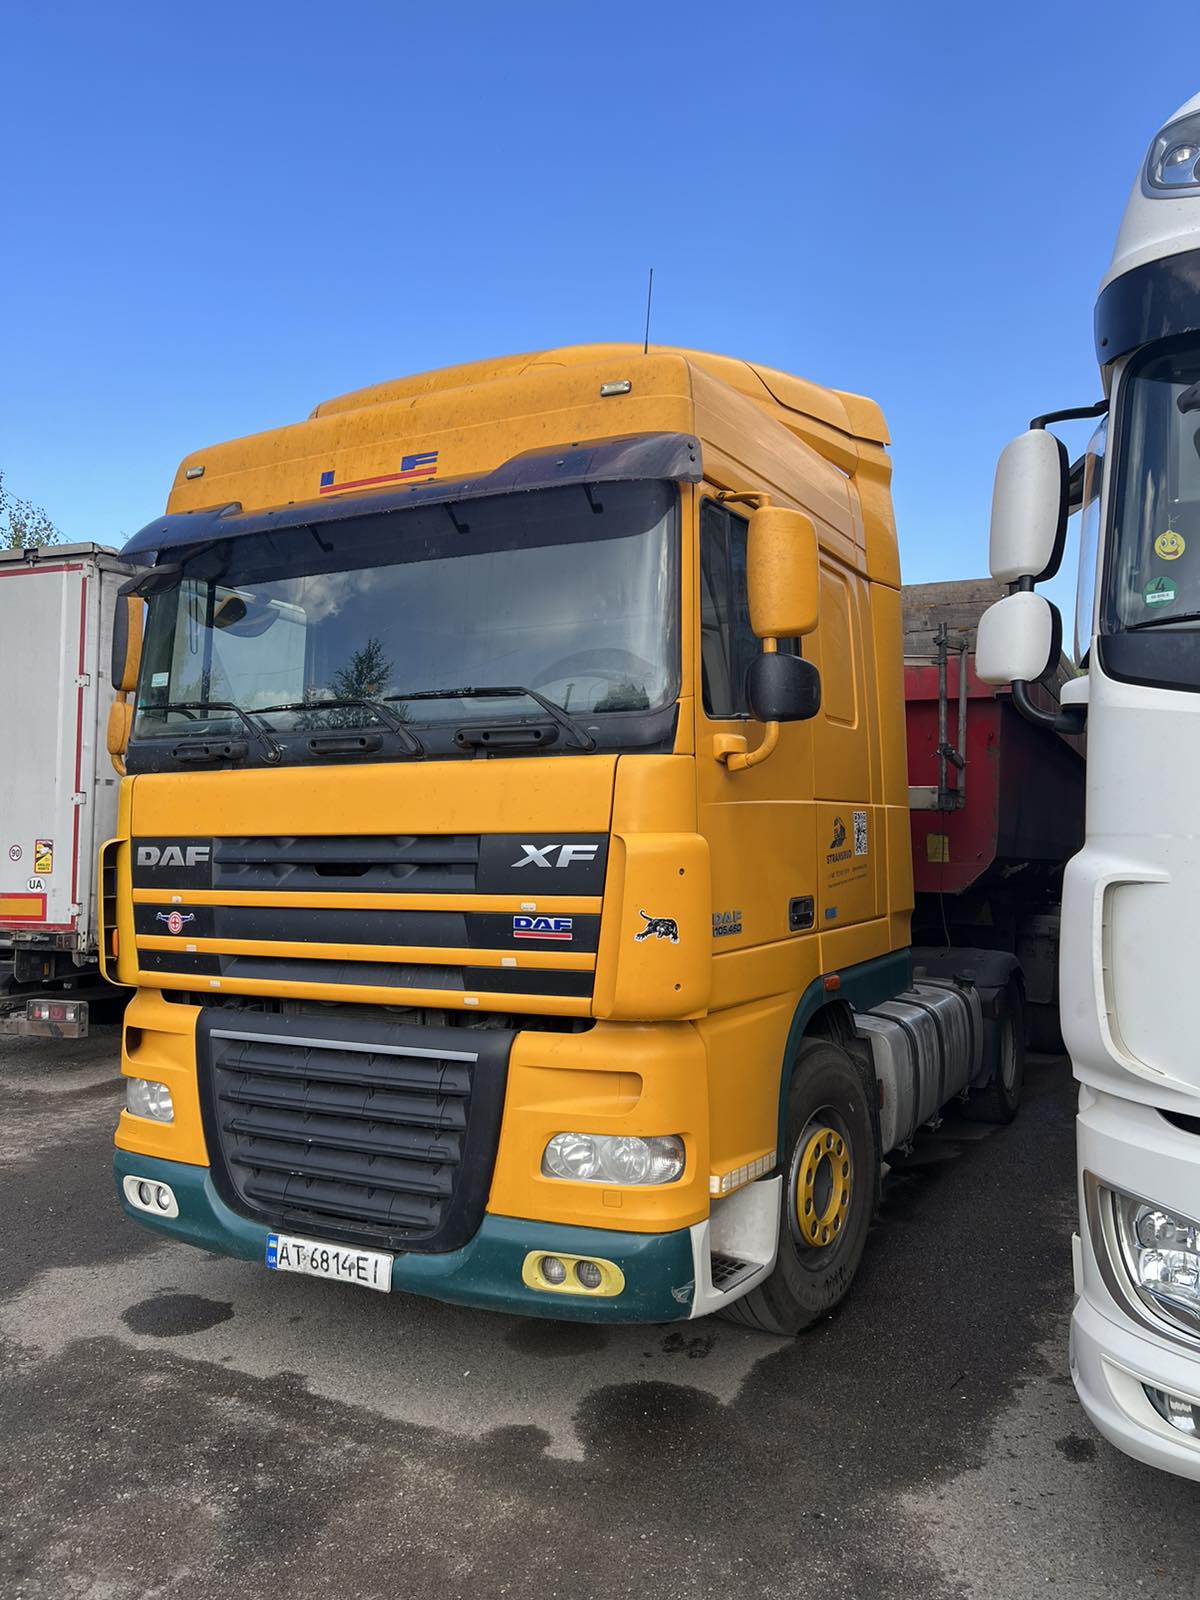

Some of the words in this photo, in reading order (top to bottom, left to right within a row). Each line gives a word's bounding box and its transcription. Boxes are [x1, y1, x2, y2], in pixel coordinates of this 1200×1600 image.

[1155, 577, 1165, 592] 4
[11, 848, 20, 858] 90
[137, 846, 210, 866] DAF
[510, 844, 599, 868] XF
[29, 879, 43, 890] UA
[513, 915, 573, 931] DAF
[712, 910, 742, 926] DAF
[267, 1255, 277, 1263] UA
